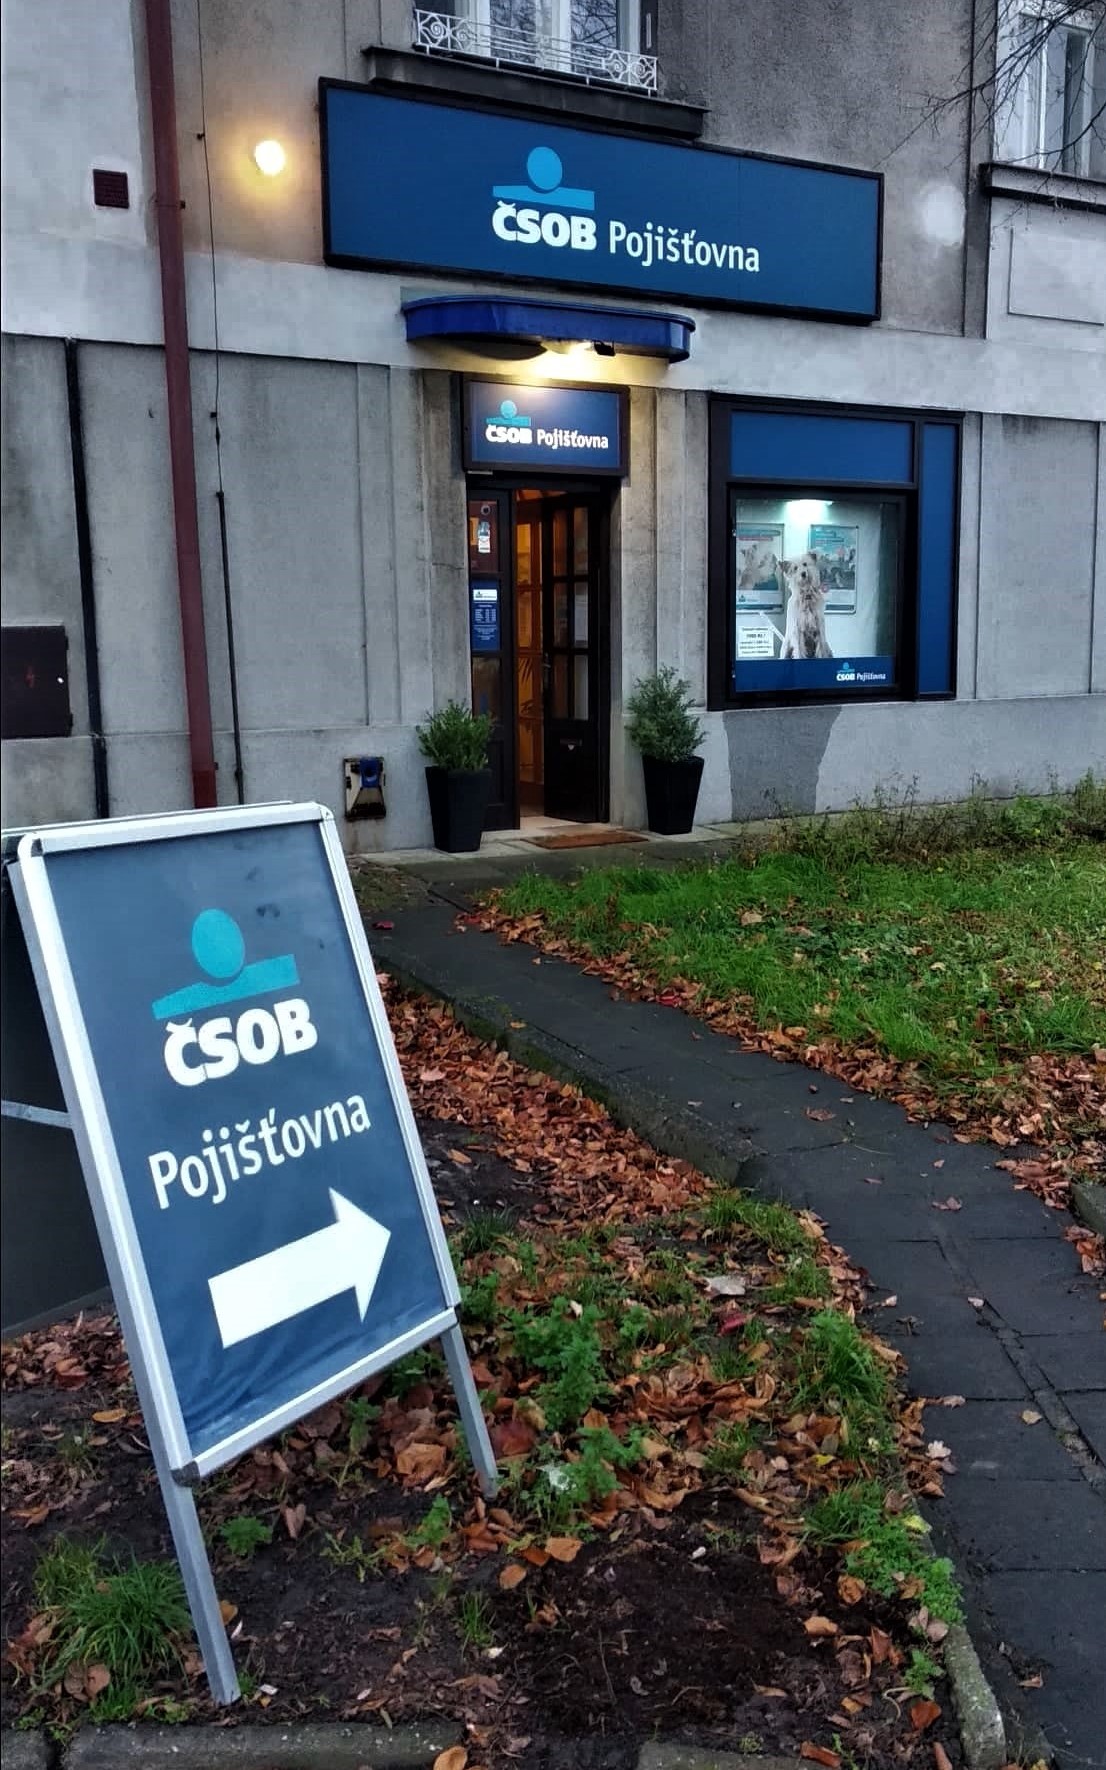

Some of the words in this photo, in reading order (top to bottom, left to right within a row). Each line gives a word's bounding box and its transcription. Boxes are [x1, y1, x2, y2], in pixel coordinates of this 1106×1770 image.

[492, 200, 597, 251] ČSOB
[609, 220, 760, 272] Pojišťovna
[485, 424, 533, 444] ČSOB
[536, 428, 609, 450] Pojišťovna
[164, 998, 318, 1087] ČSOB
[148, 1094, 372, 1209] Pojišťovna
